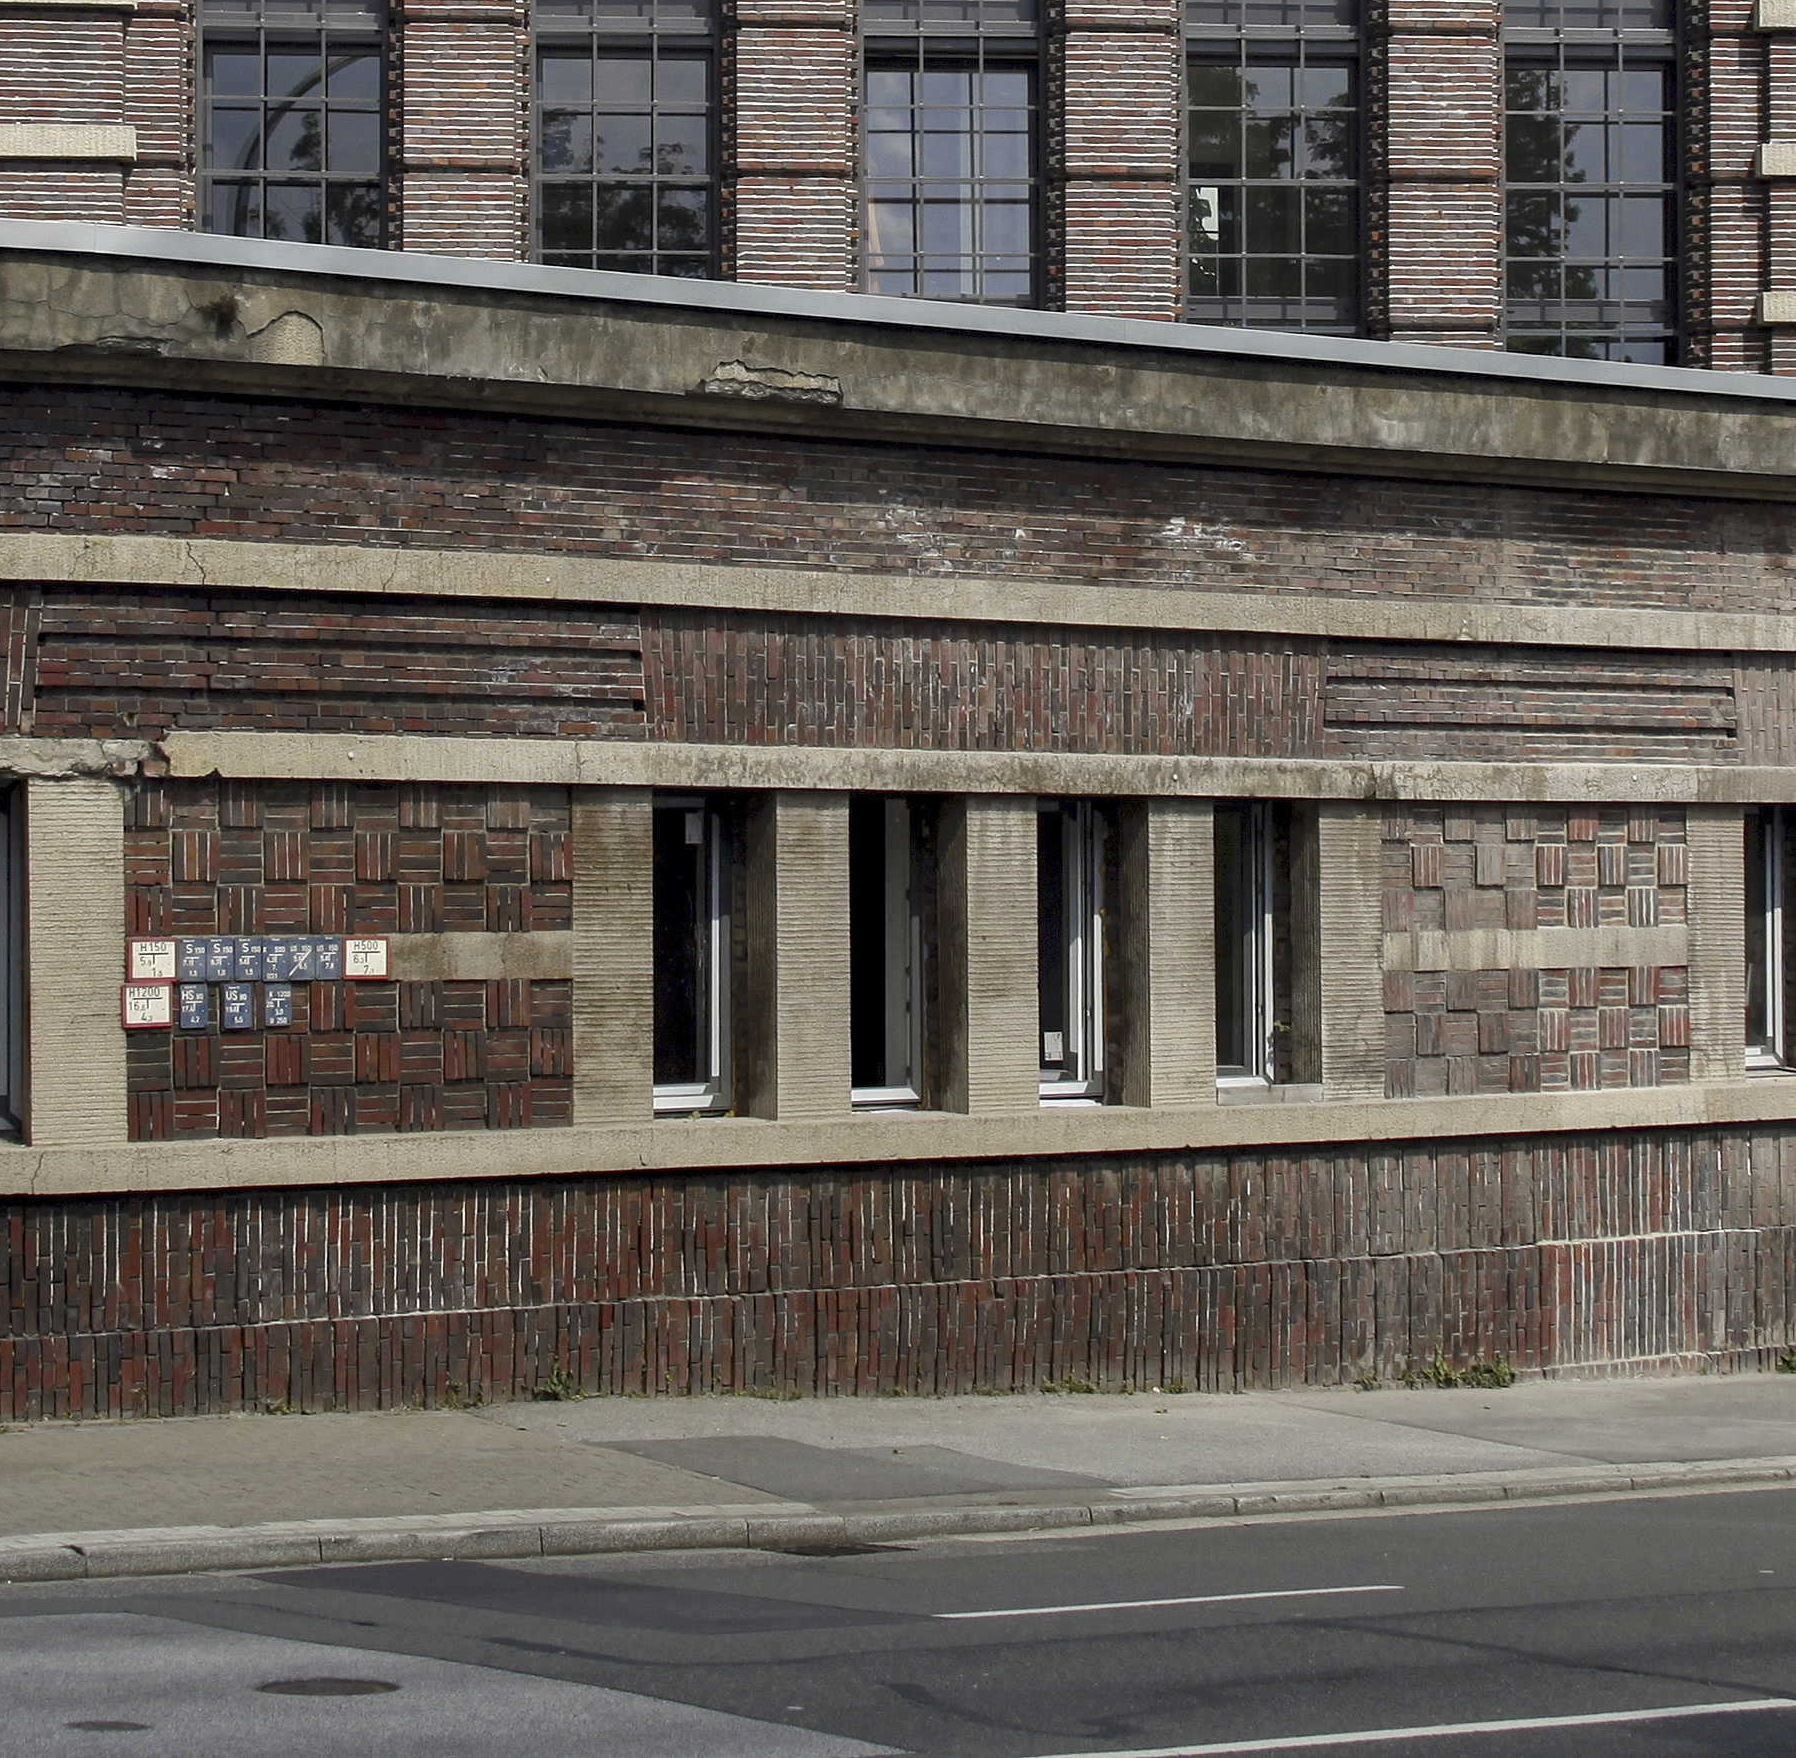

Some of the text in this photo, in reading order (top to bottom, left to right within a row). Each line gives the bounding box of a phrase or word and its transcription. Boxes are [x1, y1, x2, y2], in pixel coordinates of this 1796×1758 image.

[185, 944, 194, 954] S
[213, 943, 221, 953] S
[241, 943, 250, 953] S
[353, 941, 379, 950] H500
[128, 987, 160, 997] H1200
[181, 990, 194, 1000] HS
[225, 990, 238, 1000] US
